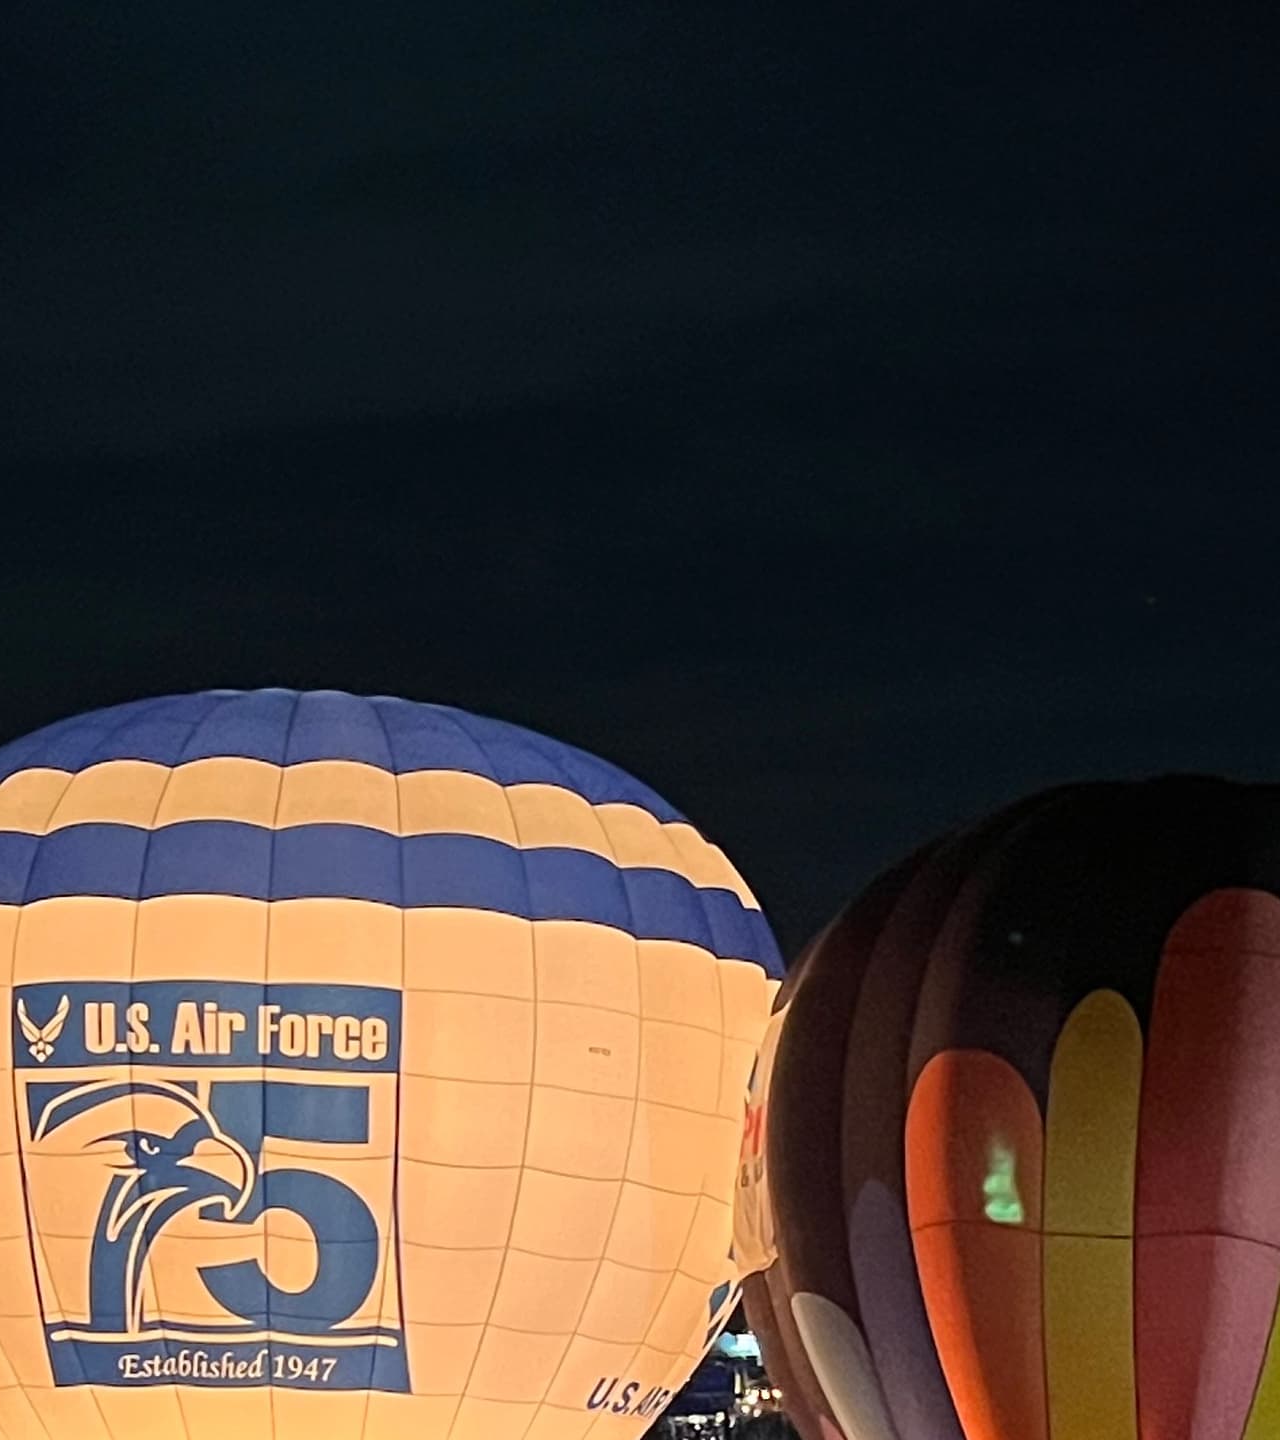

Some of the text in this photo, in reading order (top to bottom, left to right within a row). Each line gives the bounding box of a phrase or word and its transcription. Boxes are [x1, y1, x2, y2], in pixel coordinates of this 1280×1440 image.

[84, 1002, 388, 1061] U.S. Air Force
[118, 1349, 338, 1382] Established 1947
